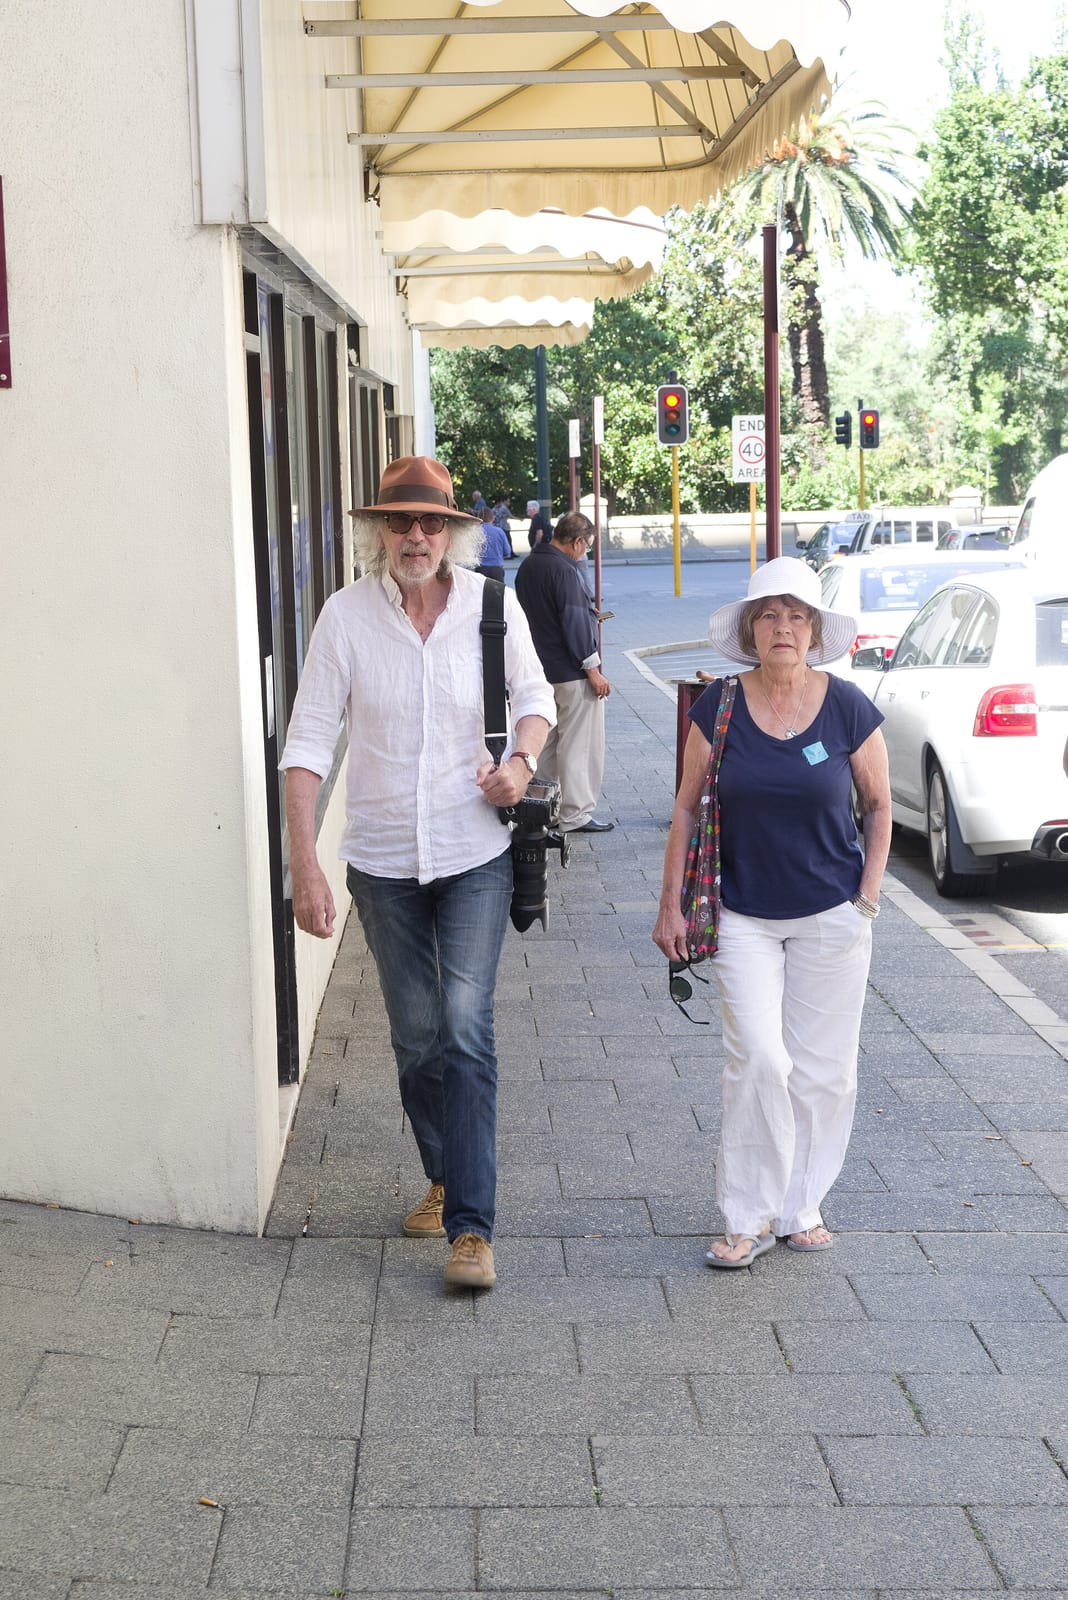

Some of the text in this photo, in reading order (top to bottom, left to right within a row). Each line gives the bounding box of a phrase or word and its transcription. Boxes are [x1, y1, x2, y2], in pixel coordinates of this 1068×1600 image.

[739, 420, 766, 431] END
[742, 443, 763, 456] 40
[738, 468, 766, 478] AREA
